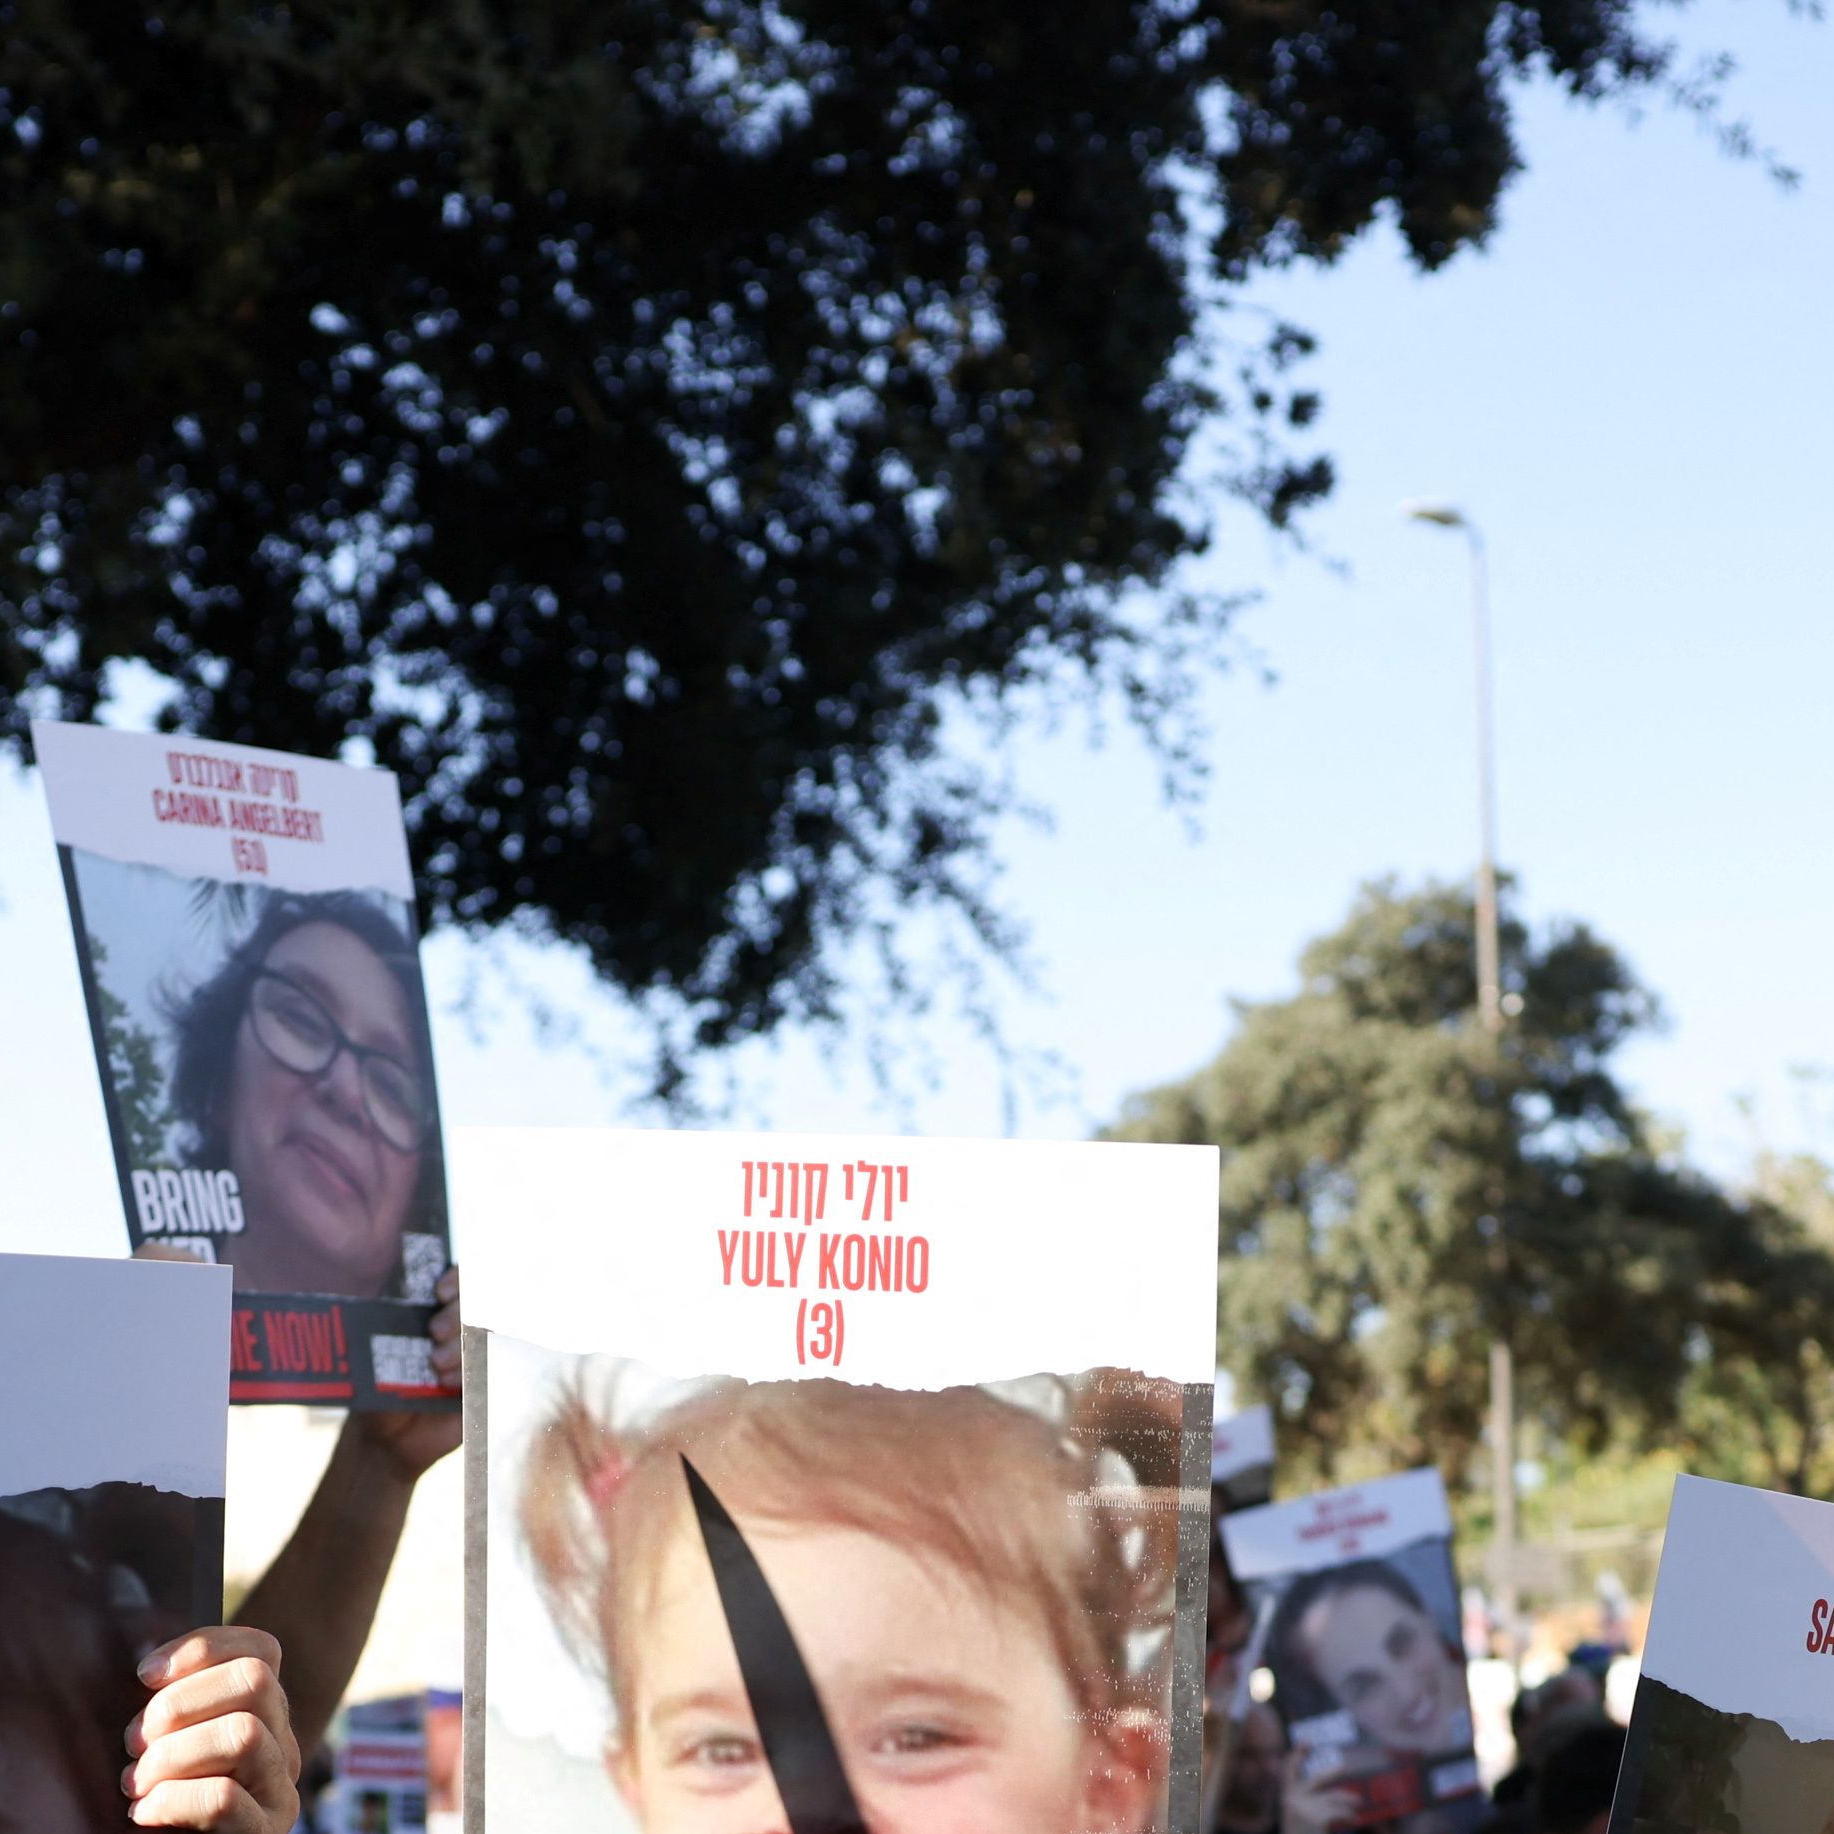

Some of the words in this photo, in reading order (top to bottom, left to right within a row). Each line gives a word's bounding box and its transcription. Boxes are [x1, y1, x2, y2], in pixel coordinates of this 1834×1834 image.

[153, 789, 227, 828] CARINA
[229, 799, 324, 842] ANGELBERT
[131, 1169, 245, 1234] BRING
[741, 1160, 829, 1225] קוניו
[842, 1161, 909, 1221] יולי
[717, 1229, 807, 1289] YULY
[818, 1234, 930, 1294] KONIO
[264, 1306, 350, 1375] NOW!
[796, 1299, 845, 1366] (3)
